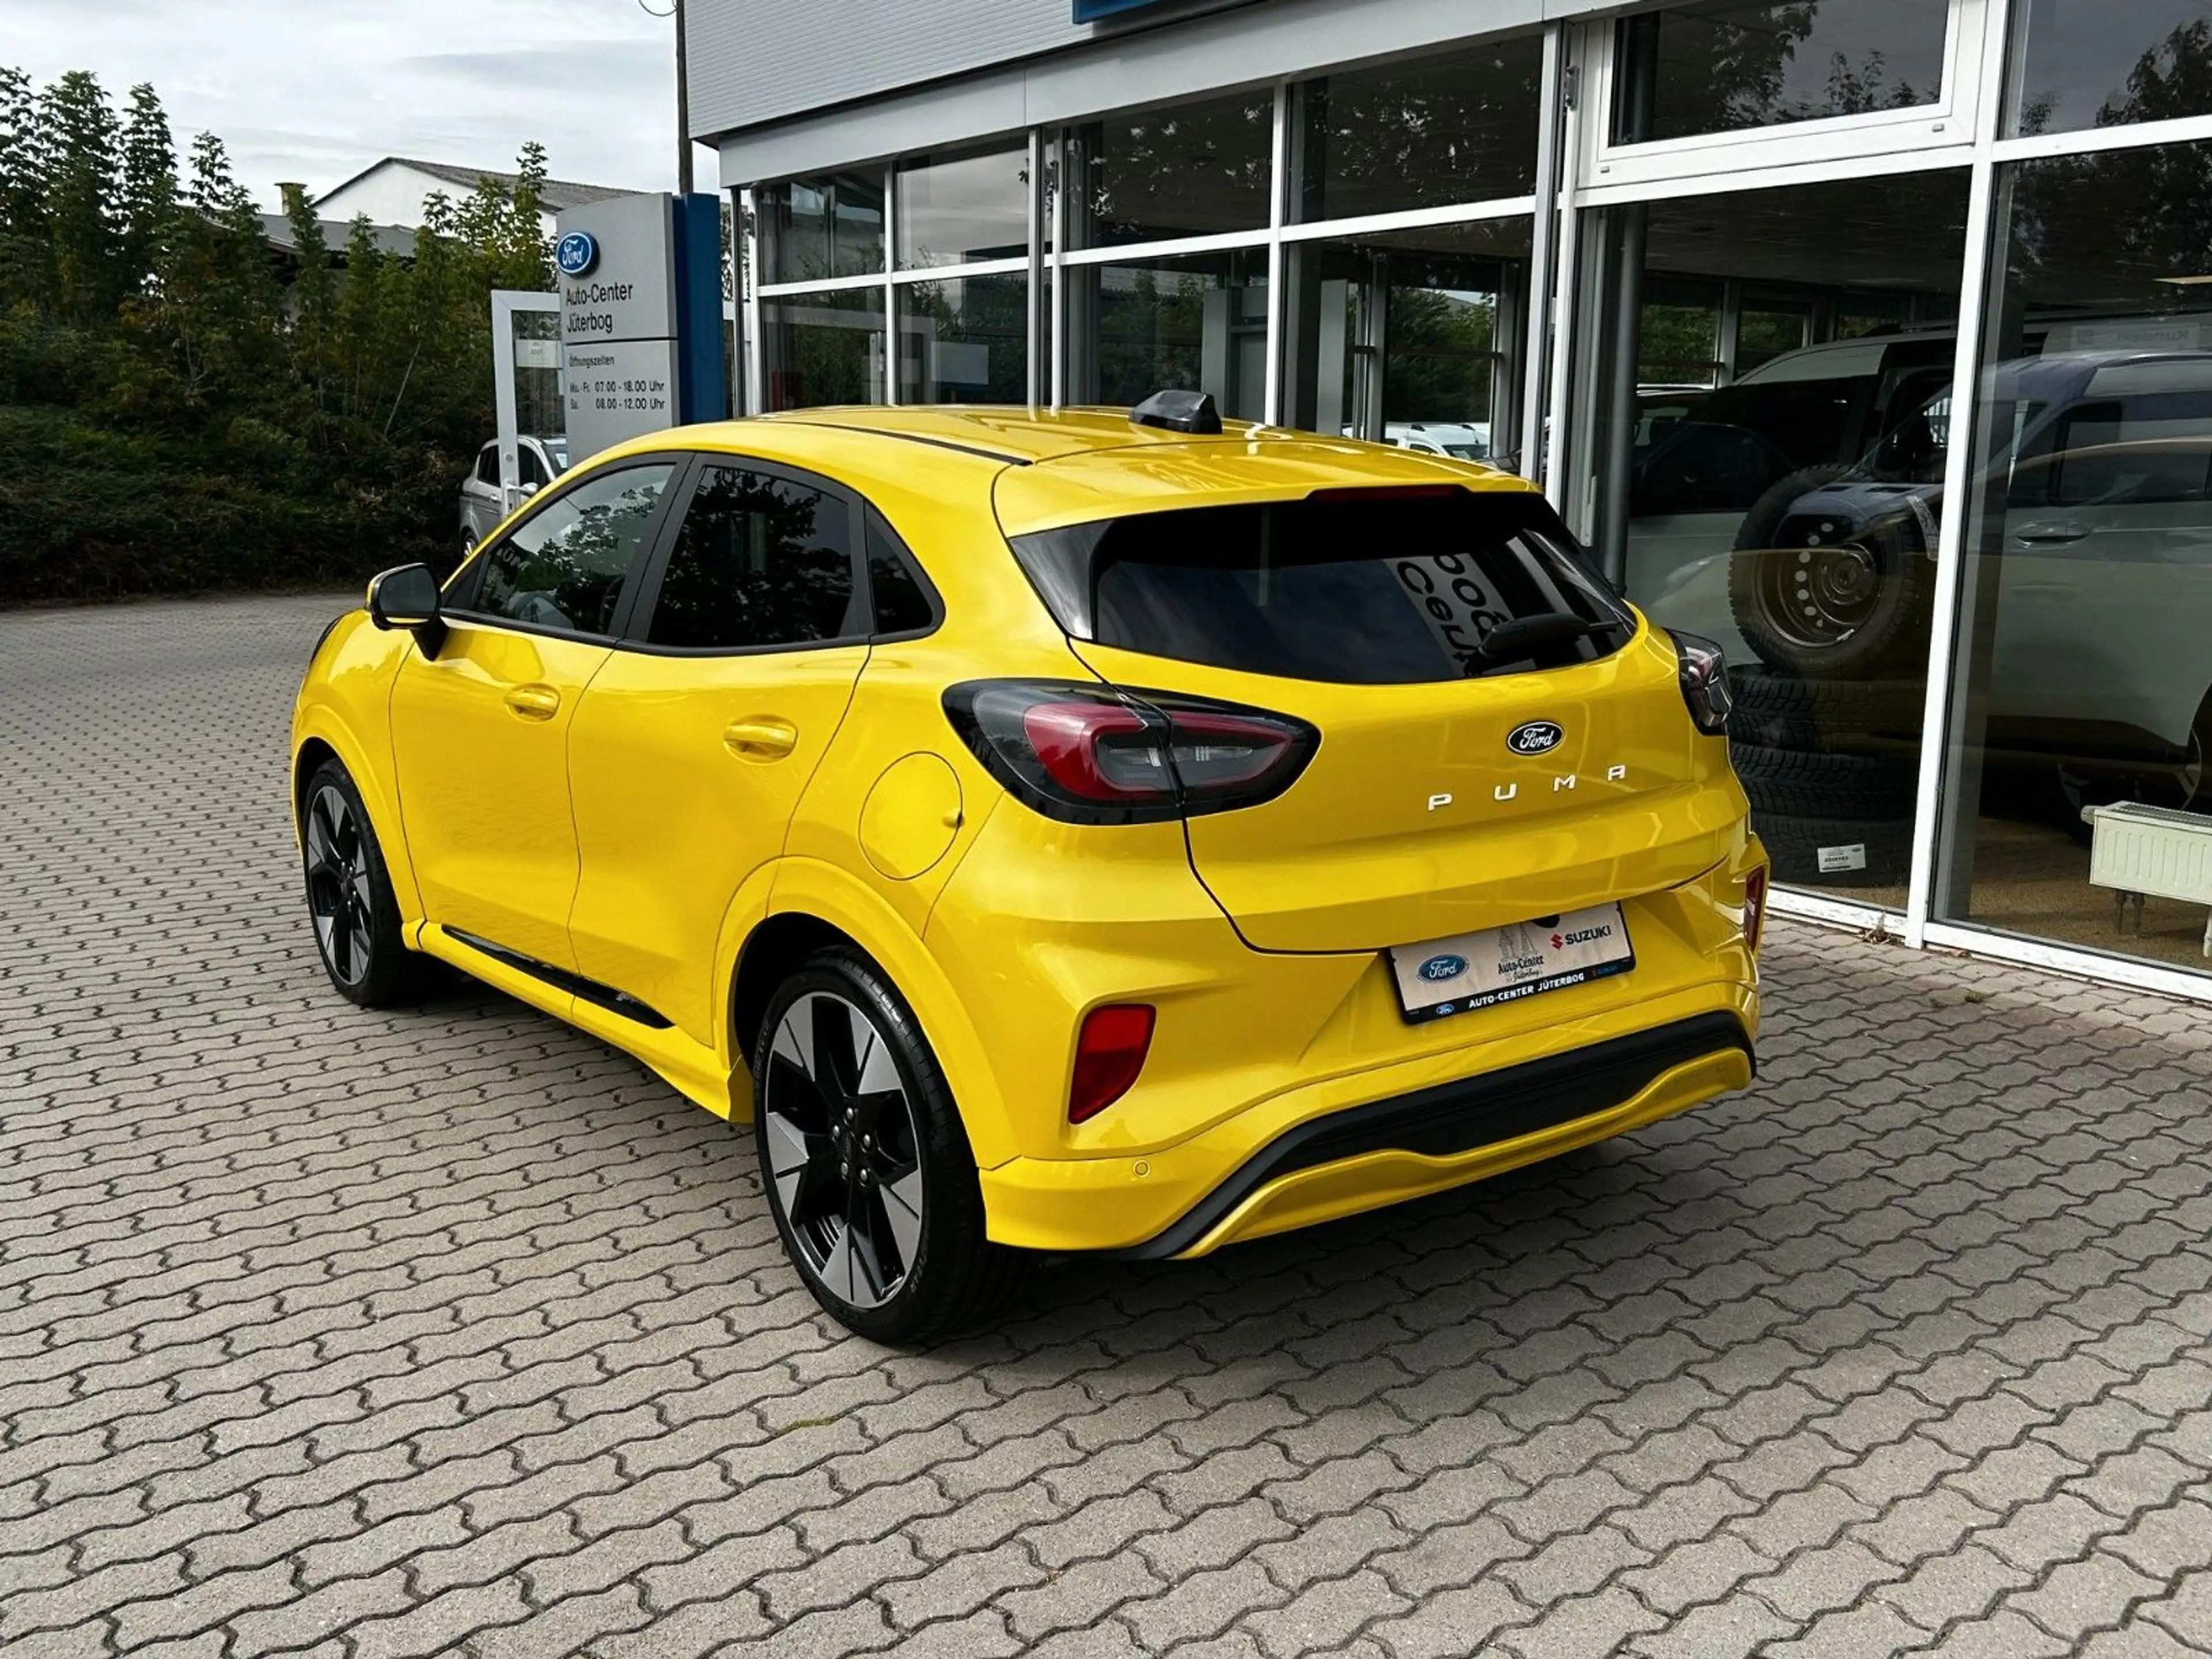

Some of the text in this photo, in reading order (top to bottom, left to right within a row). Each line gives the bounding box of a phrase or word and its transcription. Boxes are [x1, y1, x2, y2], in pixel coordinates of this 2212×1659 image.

[566, 282, 633, 306] Auto-Center
[567, 312, 612, 334] Jüterbog
[624, 380, 646, 392] 18.00
[649, 380, 665, 392] Uhr
[624, 397, 647, 410] 12.00
[650, 397, 665, 410] Uhr
[1565, 925, 1612, 945] SUZUKI
[1498, 955, 1544, 975] Auto-Center
[1469, 972, 1585, 1009] AUTO-CENTER JÜTERBOG
